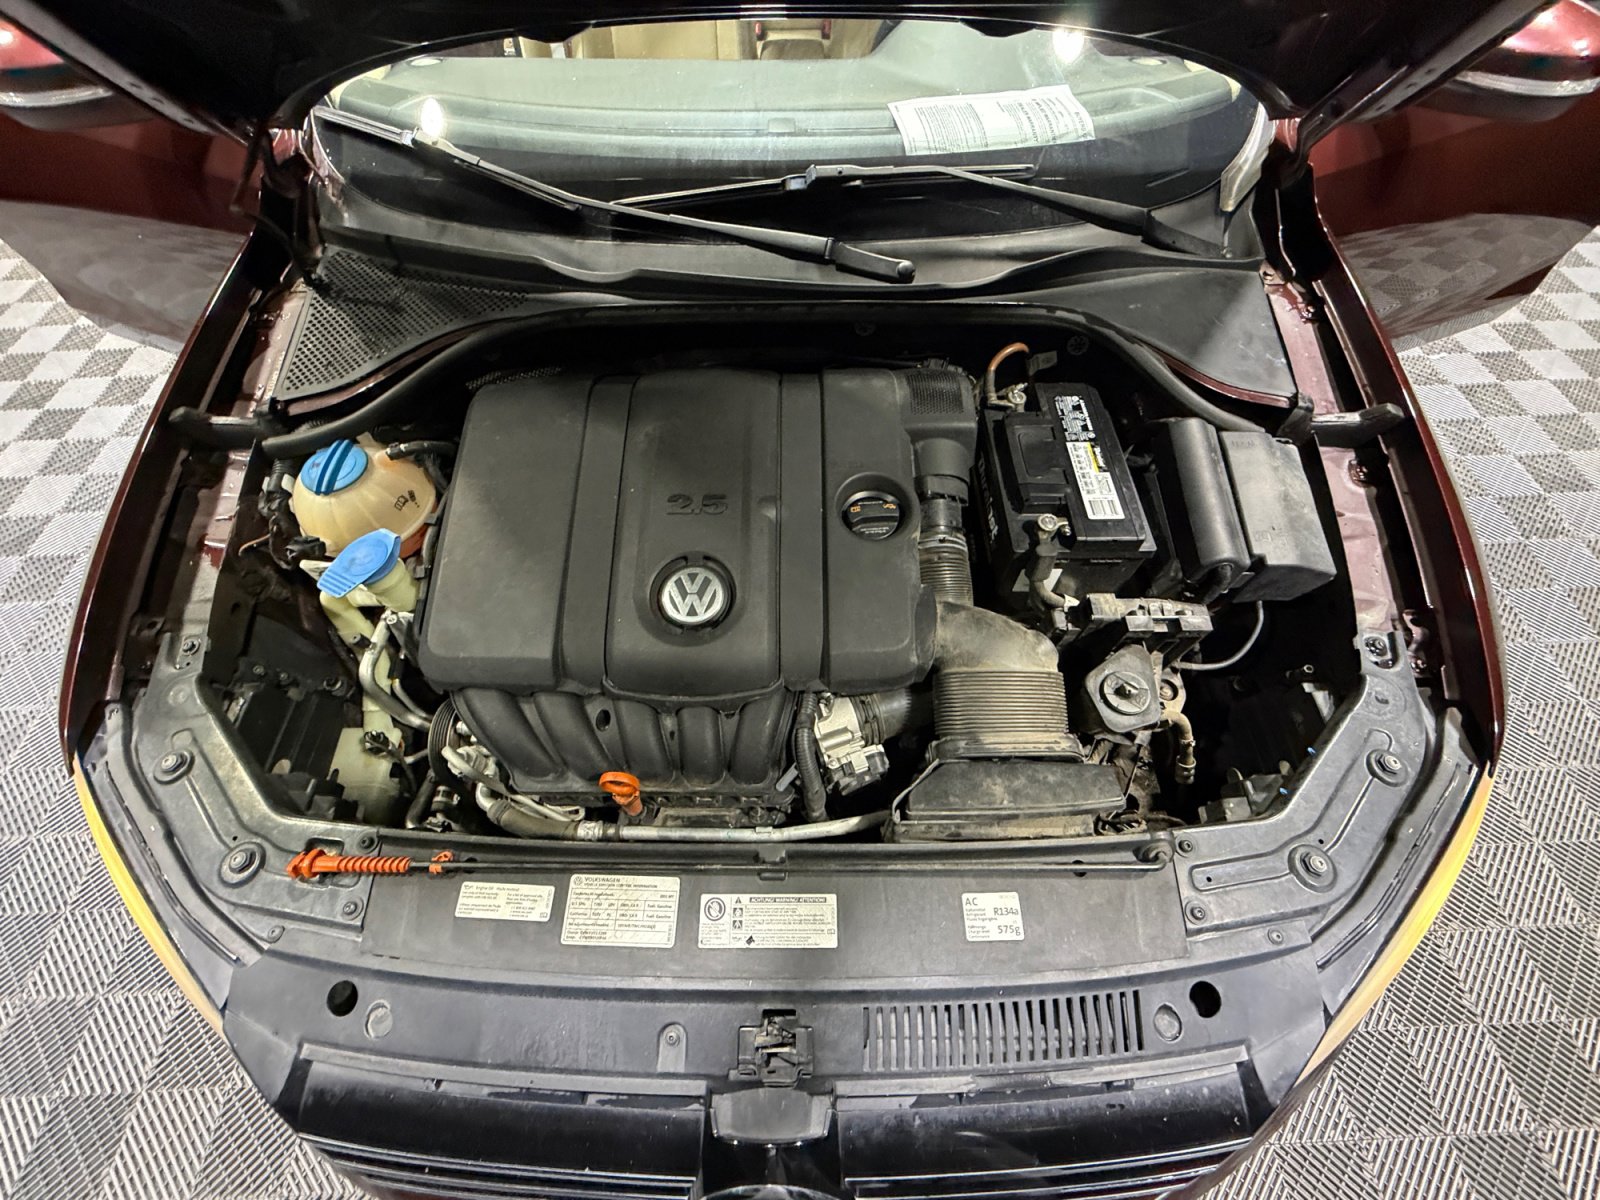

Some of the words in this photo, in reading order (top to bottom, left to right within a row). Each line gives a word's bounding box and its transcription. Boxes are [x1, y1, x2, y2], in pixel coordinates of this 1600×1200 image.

[666, 494, 728, 515] 2.5
[662, 567, 725, 623] VW
[966, 897, 978, 906] AC
[994, 907, 1019, 916] R134a
[998, 925, 1020, 936] 575g
